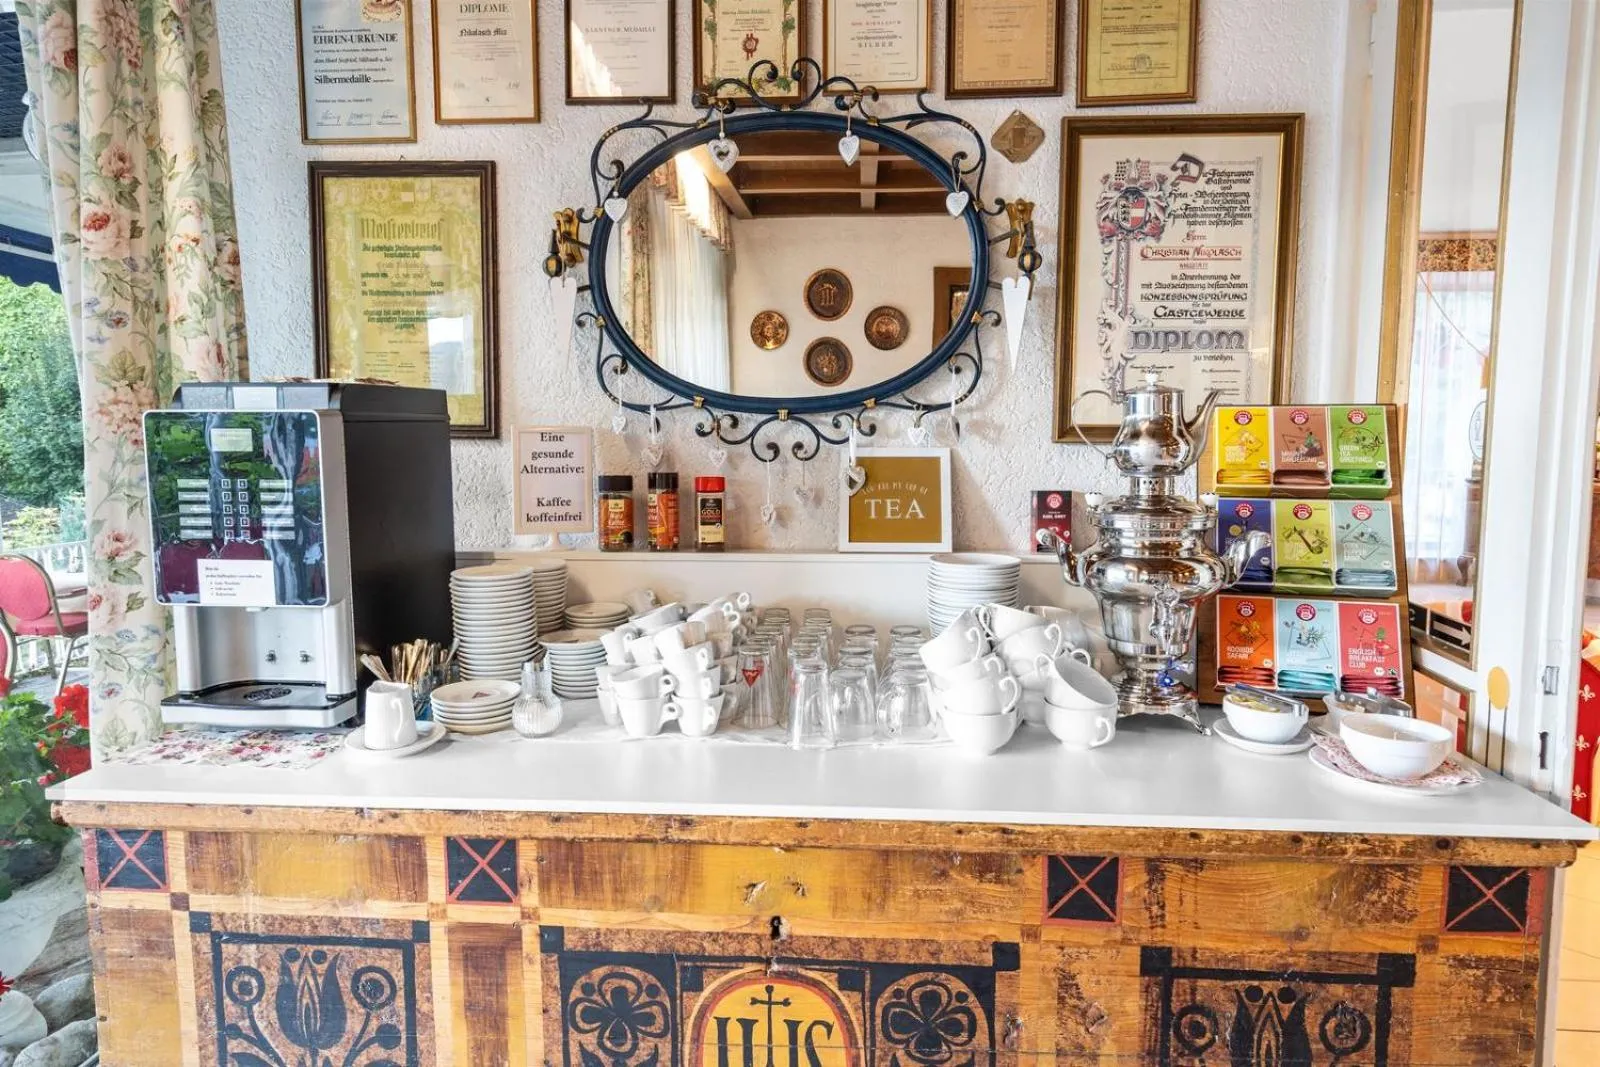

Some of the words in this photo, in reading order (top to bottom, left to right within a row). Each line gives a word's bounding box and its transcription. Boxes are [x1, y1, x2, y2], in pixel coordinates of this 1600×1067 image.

[313, 32, 399, 45] EHREN-URKUNDE
[314, 74, 372, 85] Silbermedaille
[1178, 272, 1229, 281] Anerkennung
[1229, 272, 1241, 281] der
[1140, 291, 1248, 301] KONZESSIONSPRÜFUNG
[1153, 305, 1246, 318] GASTGEWERBE
[1130, 329, 1245, 353] DIPLOM
[539, 431, 565, 443] Eine
[531, 449, 575, 461] gesunde
[520, 464, 585, 475] Alternative:
[536, 497, 572, 508] Kaffee
[864, 498, 925, 520] TEA
[526, 511, 583, 523] koffeinfrei
[1348, 647, 1376, 655] ENGLISH
[1348, 654, 1385, 663] BREAKFAST
